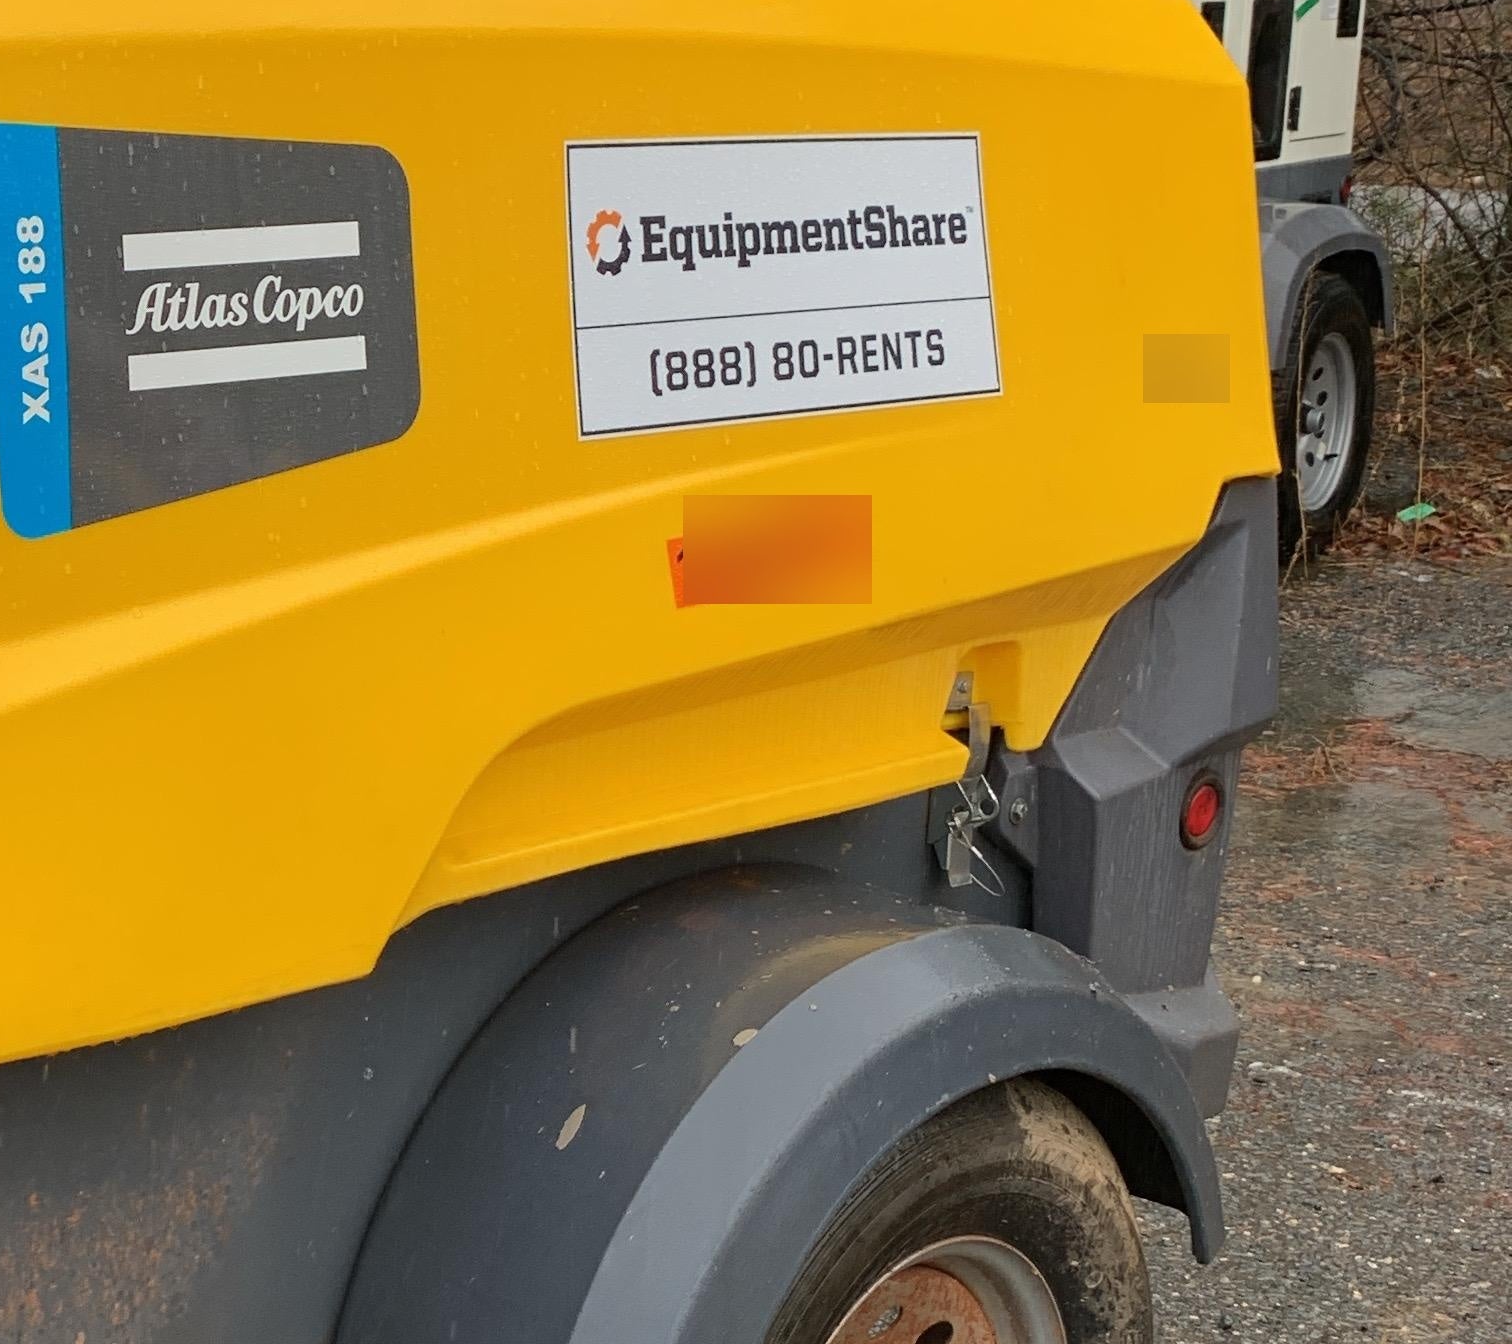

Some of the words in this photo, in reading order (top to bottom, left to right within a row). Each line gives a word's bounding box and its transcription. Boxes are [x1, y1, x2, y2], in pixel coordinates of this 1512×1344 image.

[16, 215, 47, 304] 188
[639, 205, 968, 272] EquipmentShare
[125, 282, 248, 335] Atlas
[253, 274, 365, 332] Copco
[20, 323, 50, 425] XAS
[650, 340, 757, 397] (888)
[772, 328, 946, 381] 80-RENTS
